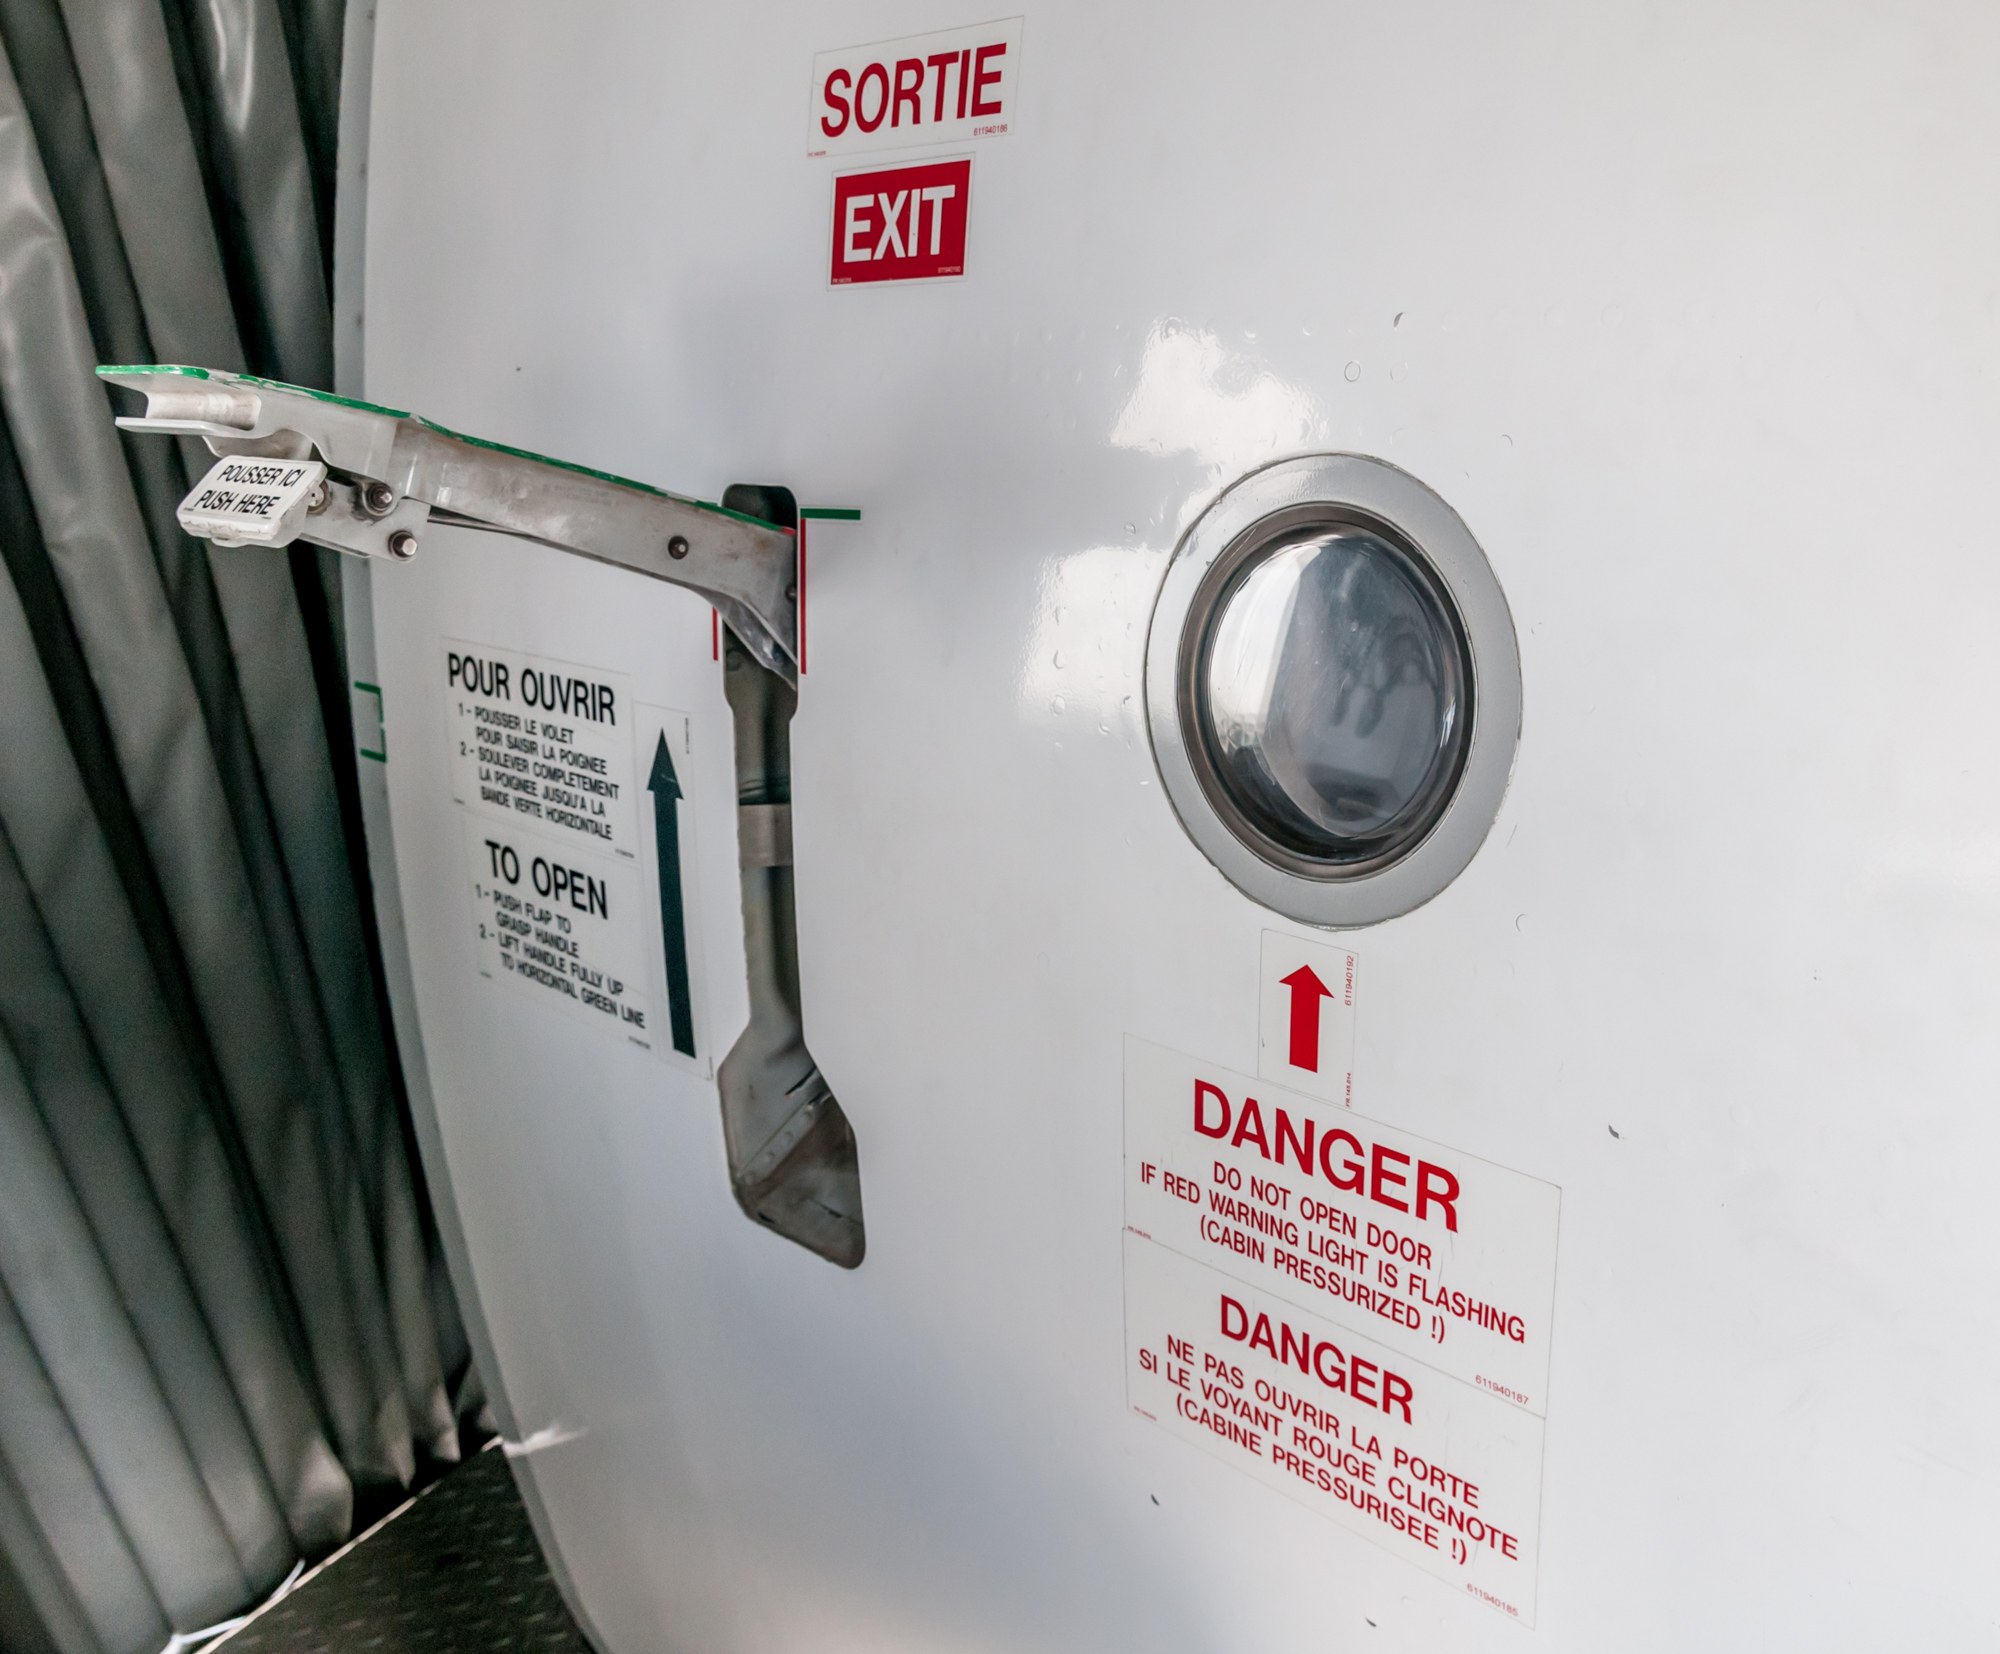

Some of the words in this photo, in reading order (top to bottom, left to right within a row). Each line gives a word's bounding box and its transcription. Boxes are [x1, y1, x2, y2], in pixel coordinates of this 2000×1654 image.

[821, 43, 1006, 137] SORTIE
[844, 184, 955, 262] EXIT
[194, 490, 237, 511] PUSH
[234, 494, 280, 516] HERE
[217, 465, 283, 485] POUSSER
[279, 469, 306, 487] ICI
[449, 653, 510, 700] POUR
[521, 669, 615, 726] OUVRIR
[475, 706, 521, 730] POUSSER
[524, 718, 537, 736] LE
[541, 723, 574, 744] VOLET
[476, 726, 501, 744] POUR
[506, 734, 538, 755] SAISIR
[542, 744, 556, 760] LA
[560, 748, 607, 775] POIGNEE
[478, 746, 529, 774] SOULEVER
[533, 762, 619, 800] COMPLETEMENT
[479, 767, 492, 782] LA
[495, 770, 538, 796] POIGNEE
[591, 799, 606, 817] LA
[481, 786, 511, 808] BANDE
[513, 796, 542, 818] VERTE
[546, 804, 612, 840] HORIZONTALE
[485, 840, 520, 884] TO
[532, 857, 608, 920] OPEN
[494, 890, 522, 914] PUSH
[525, 903, 552, 926] FLAP
[556, 914, 572, 934] TO
[496, 911, 532, 937] GRASP
[535, 928, 579, 958] HANDLE
[499, 931, 520, 953] LIFT
[524, 945, 566, 974] HANDLE
[571, 962, 604, 991] FULLY
[607, 977, 624, 997] UP
[501, 952, 514, 970] TO
[517, 962, 578, 999] HORIZONTAL
[581, 987, 617, 1017] GREEN
[621, 1004, 645, 1029] LINE
[1345, 955, 1354, 1006] 611940192
[1194, 1078, 1460, 1233] DANGER
[1214, 1161, 1241, 1191] DO
[1251, 1179, 1291, 1211] NOT
[1300, 1197, 1357, 1238] OPEN
[1367, 1227, 1432, 1269] DOOR
[1141, 1162, 1157, 1184] IF
[1164, 1171, 1200, 1204] RED
[1209, 1189, 1298, 1247] WARNING
[1308, 1238, 1369, 1275] LIGHT
[1378, 1259, 1398, 1288] IS
[1409, 1273, 1525, 1344] FLASHING
[1200, 1214, 1265, 1263] (CABIN
[1274, 1248, 1421, 1331] PRESSURIZED
[1220, 1293, 1414, 1426] DANGER
[1475, 1374, 1529, 1406] 611940187
[1139, 1348, 1157, 1374] SI
[1167, 1361, 1190, 1391] LE
[1200, 1378, 1283, 1435] VOYANT
[1293, 1428, 1376, 1487] ROUGE
[1388, 1476, 1519, 1561] CLIGNOTE
[1168, 1334, 1194, 1366] NE
[1204, 1353, 1244, 1390] PAS
[1255, 1380, 1339, 1439] OUVRIR
[1352, 1426, 1382, 1460] LA
[1394, 1446, 1479, 1509] PORTE
[1177, 1392, 1262, 1456] (CABINE
[1272, 1444, 1439, 1550] PRESSURISEE
[1467, 1583, 1519, 1617] 611940185
